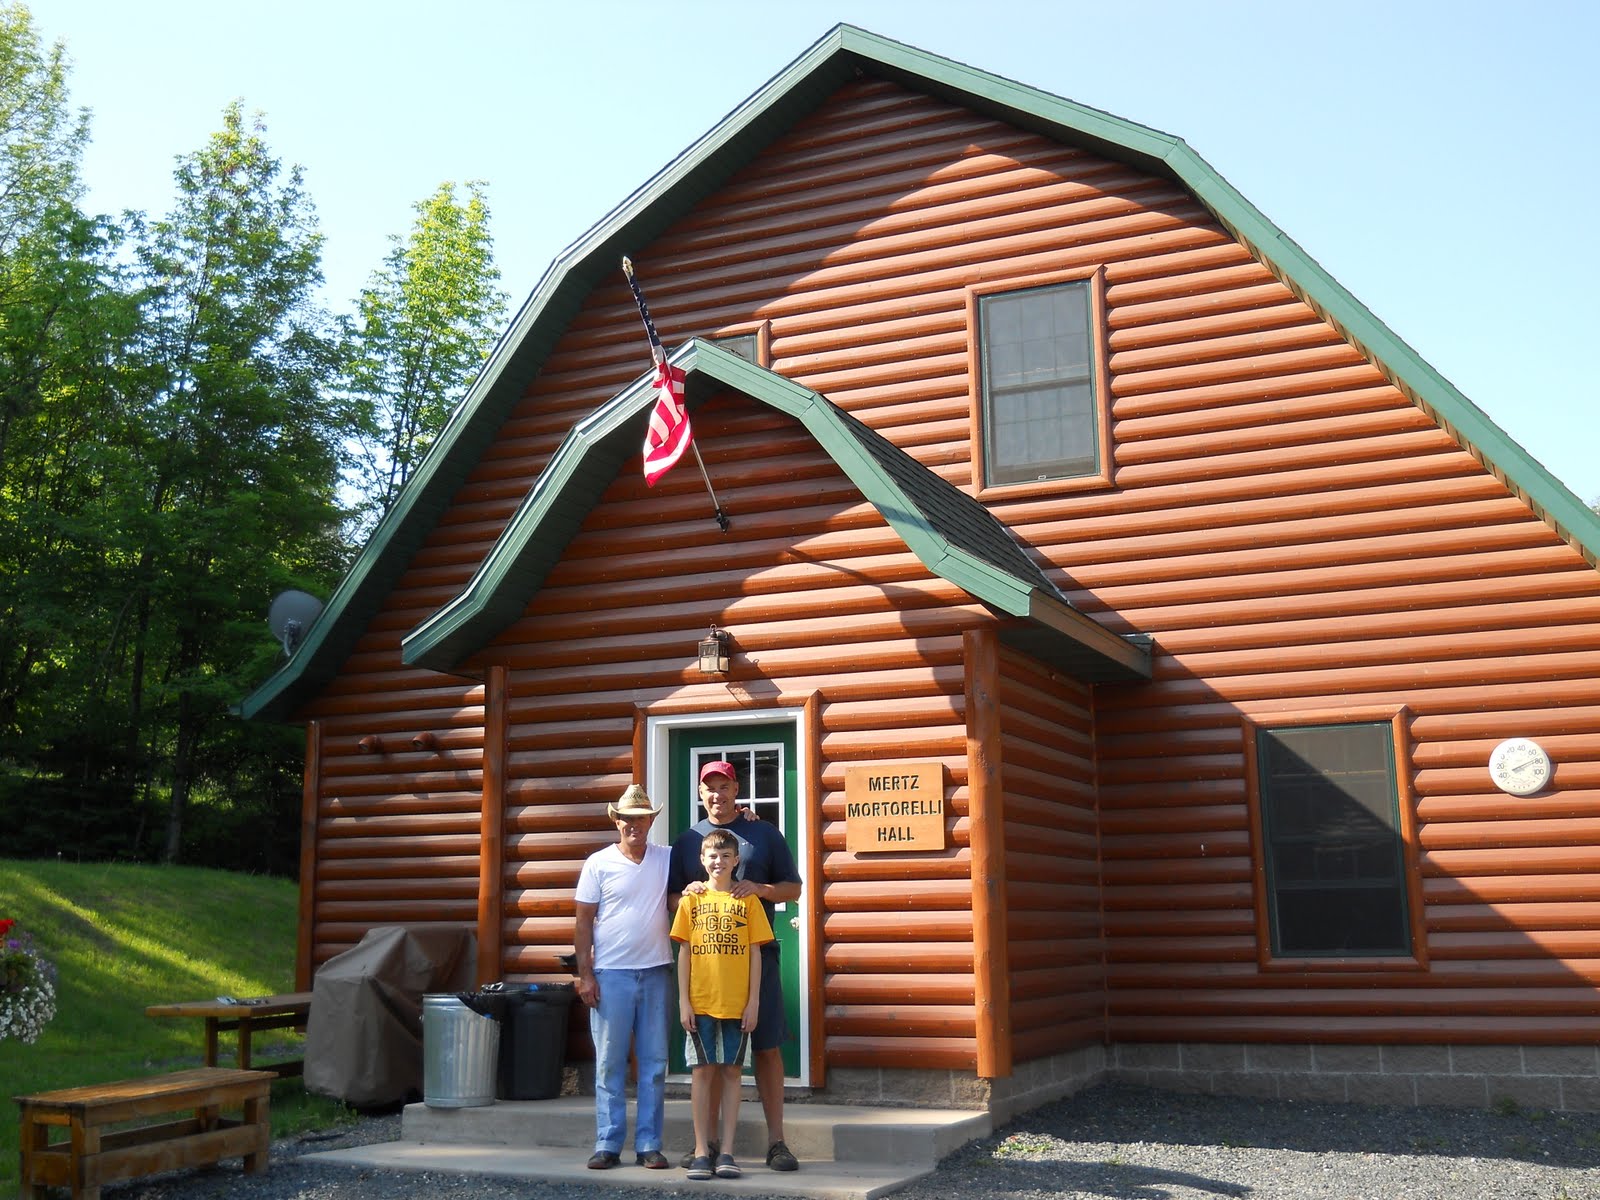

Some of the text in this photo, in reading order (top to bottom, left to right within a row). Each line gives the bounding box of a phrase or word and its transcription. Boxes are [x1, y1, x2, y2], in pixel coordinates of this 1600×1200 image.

[868, 775, 919, 791] MERTZ
[848, 800, 941, 817] MORTORELLI
[878, 826, 914, 841] HALL
[692, 902, 748, 919] SHELL LAKE
[706, 914, 732, 932] CC
[702, 933, 738, 944] CROSS
[692, 944, 746, 955] COUNTRY
